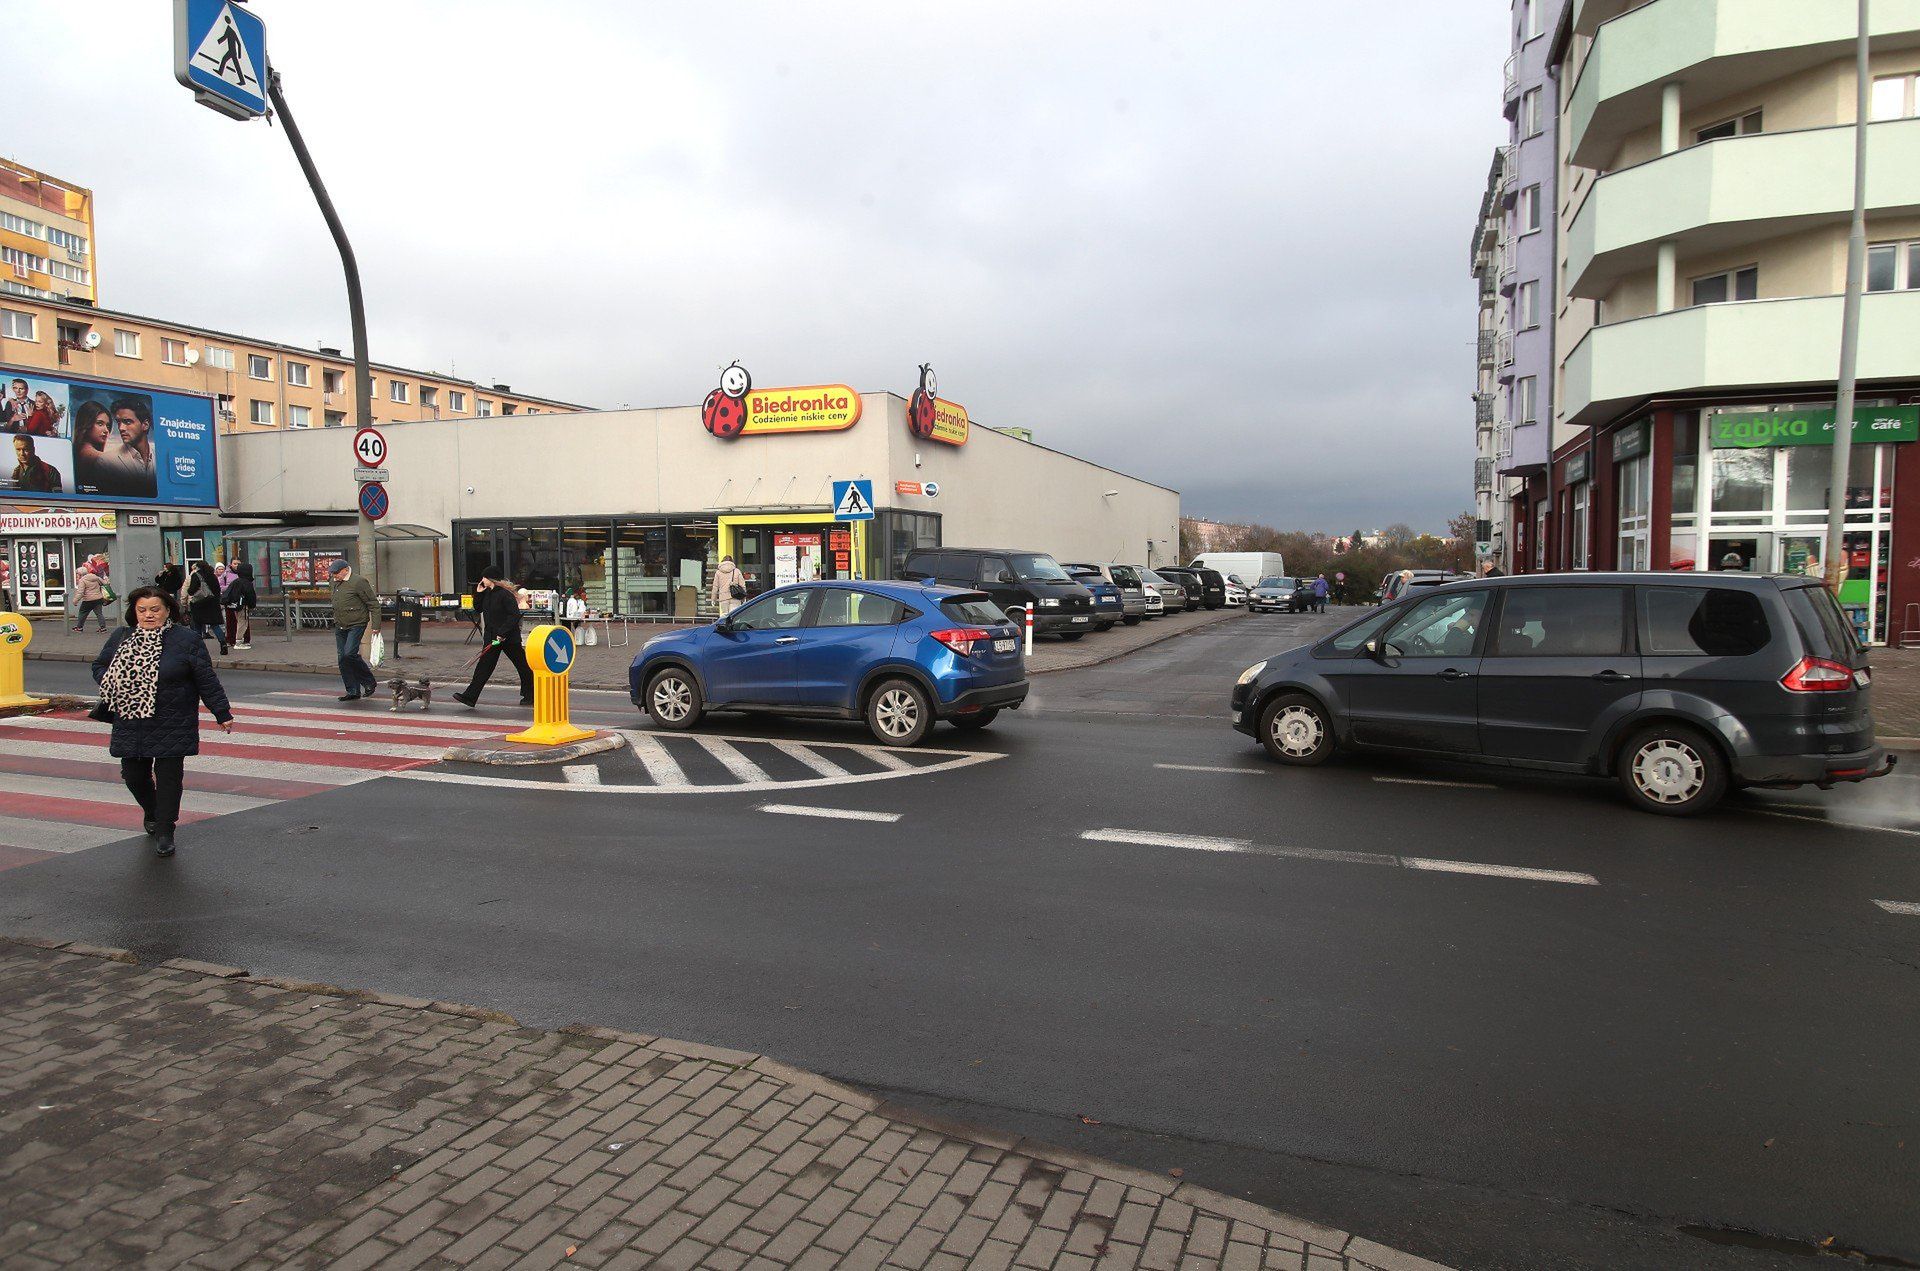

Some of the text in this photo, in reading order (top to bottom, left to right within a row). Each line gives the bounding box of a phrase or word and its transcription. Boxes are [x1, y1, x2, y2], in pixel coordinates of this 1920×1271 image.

[752, 393, 848, 414] Biedronka
[752, 412, 848, 424] Codziennie niskie ceny
[934, 405, 966, 428] iedronka
[160, 416, 206, 431] Znajdziesz
[1718, 417, 1808, 440] żabka
[1871, 418, 1902, 430] café
[167, 428, 200, 440] to u nas
[359, 438, 382, 457] 40
[174, 456, 196, 465] prime
[176, 464, 196, 472] video
[0, 517, 40, 531] WĘDLINY
[45, 515, 72, 527] DRÓB
[75, 517, 98, 530] JAJA
[132, 516, 155, 524] ams
